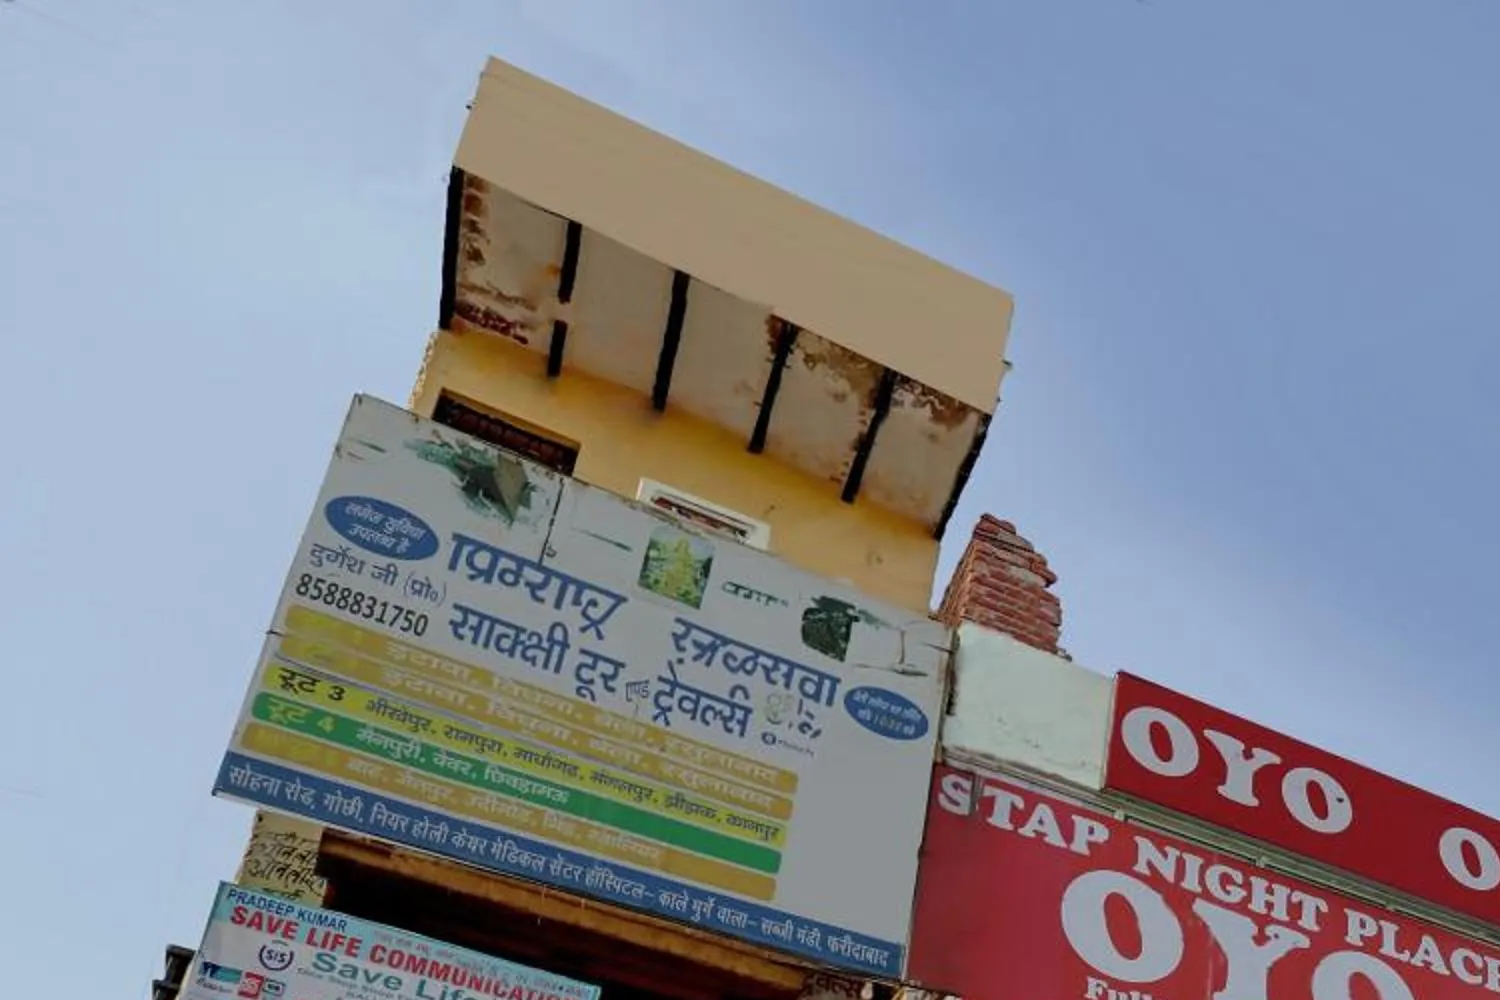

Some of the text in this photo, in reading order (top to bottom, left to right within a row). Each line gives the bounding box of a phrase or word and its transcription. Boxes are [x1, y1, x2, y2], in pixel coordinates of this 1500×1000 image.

[370, 558, 399, 588] जी
[295, 573, 429, 637] 8588831750
[276, 667, 321, 696] रूट
[327, 685, 346, 701] 3
[574, 647, 626, 702] टूर
[316, 716, 336, 734] 4
[1121, 705, 1353, 834] OYO
[229, 764, 279, 799] सोहना
[413, 814, 450, 845] होली
[827, 933, 890, 968] फरीदाबाद
[1133, 835, 1328, 933] NIGHT
[226, 888, 348, 933] PRADEEP KUMAR
[230, 905, 300, 941] SAVE
[305, 927, 363, 958] LIFE
[312, 951, 403, 992] Save
